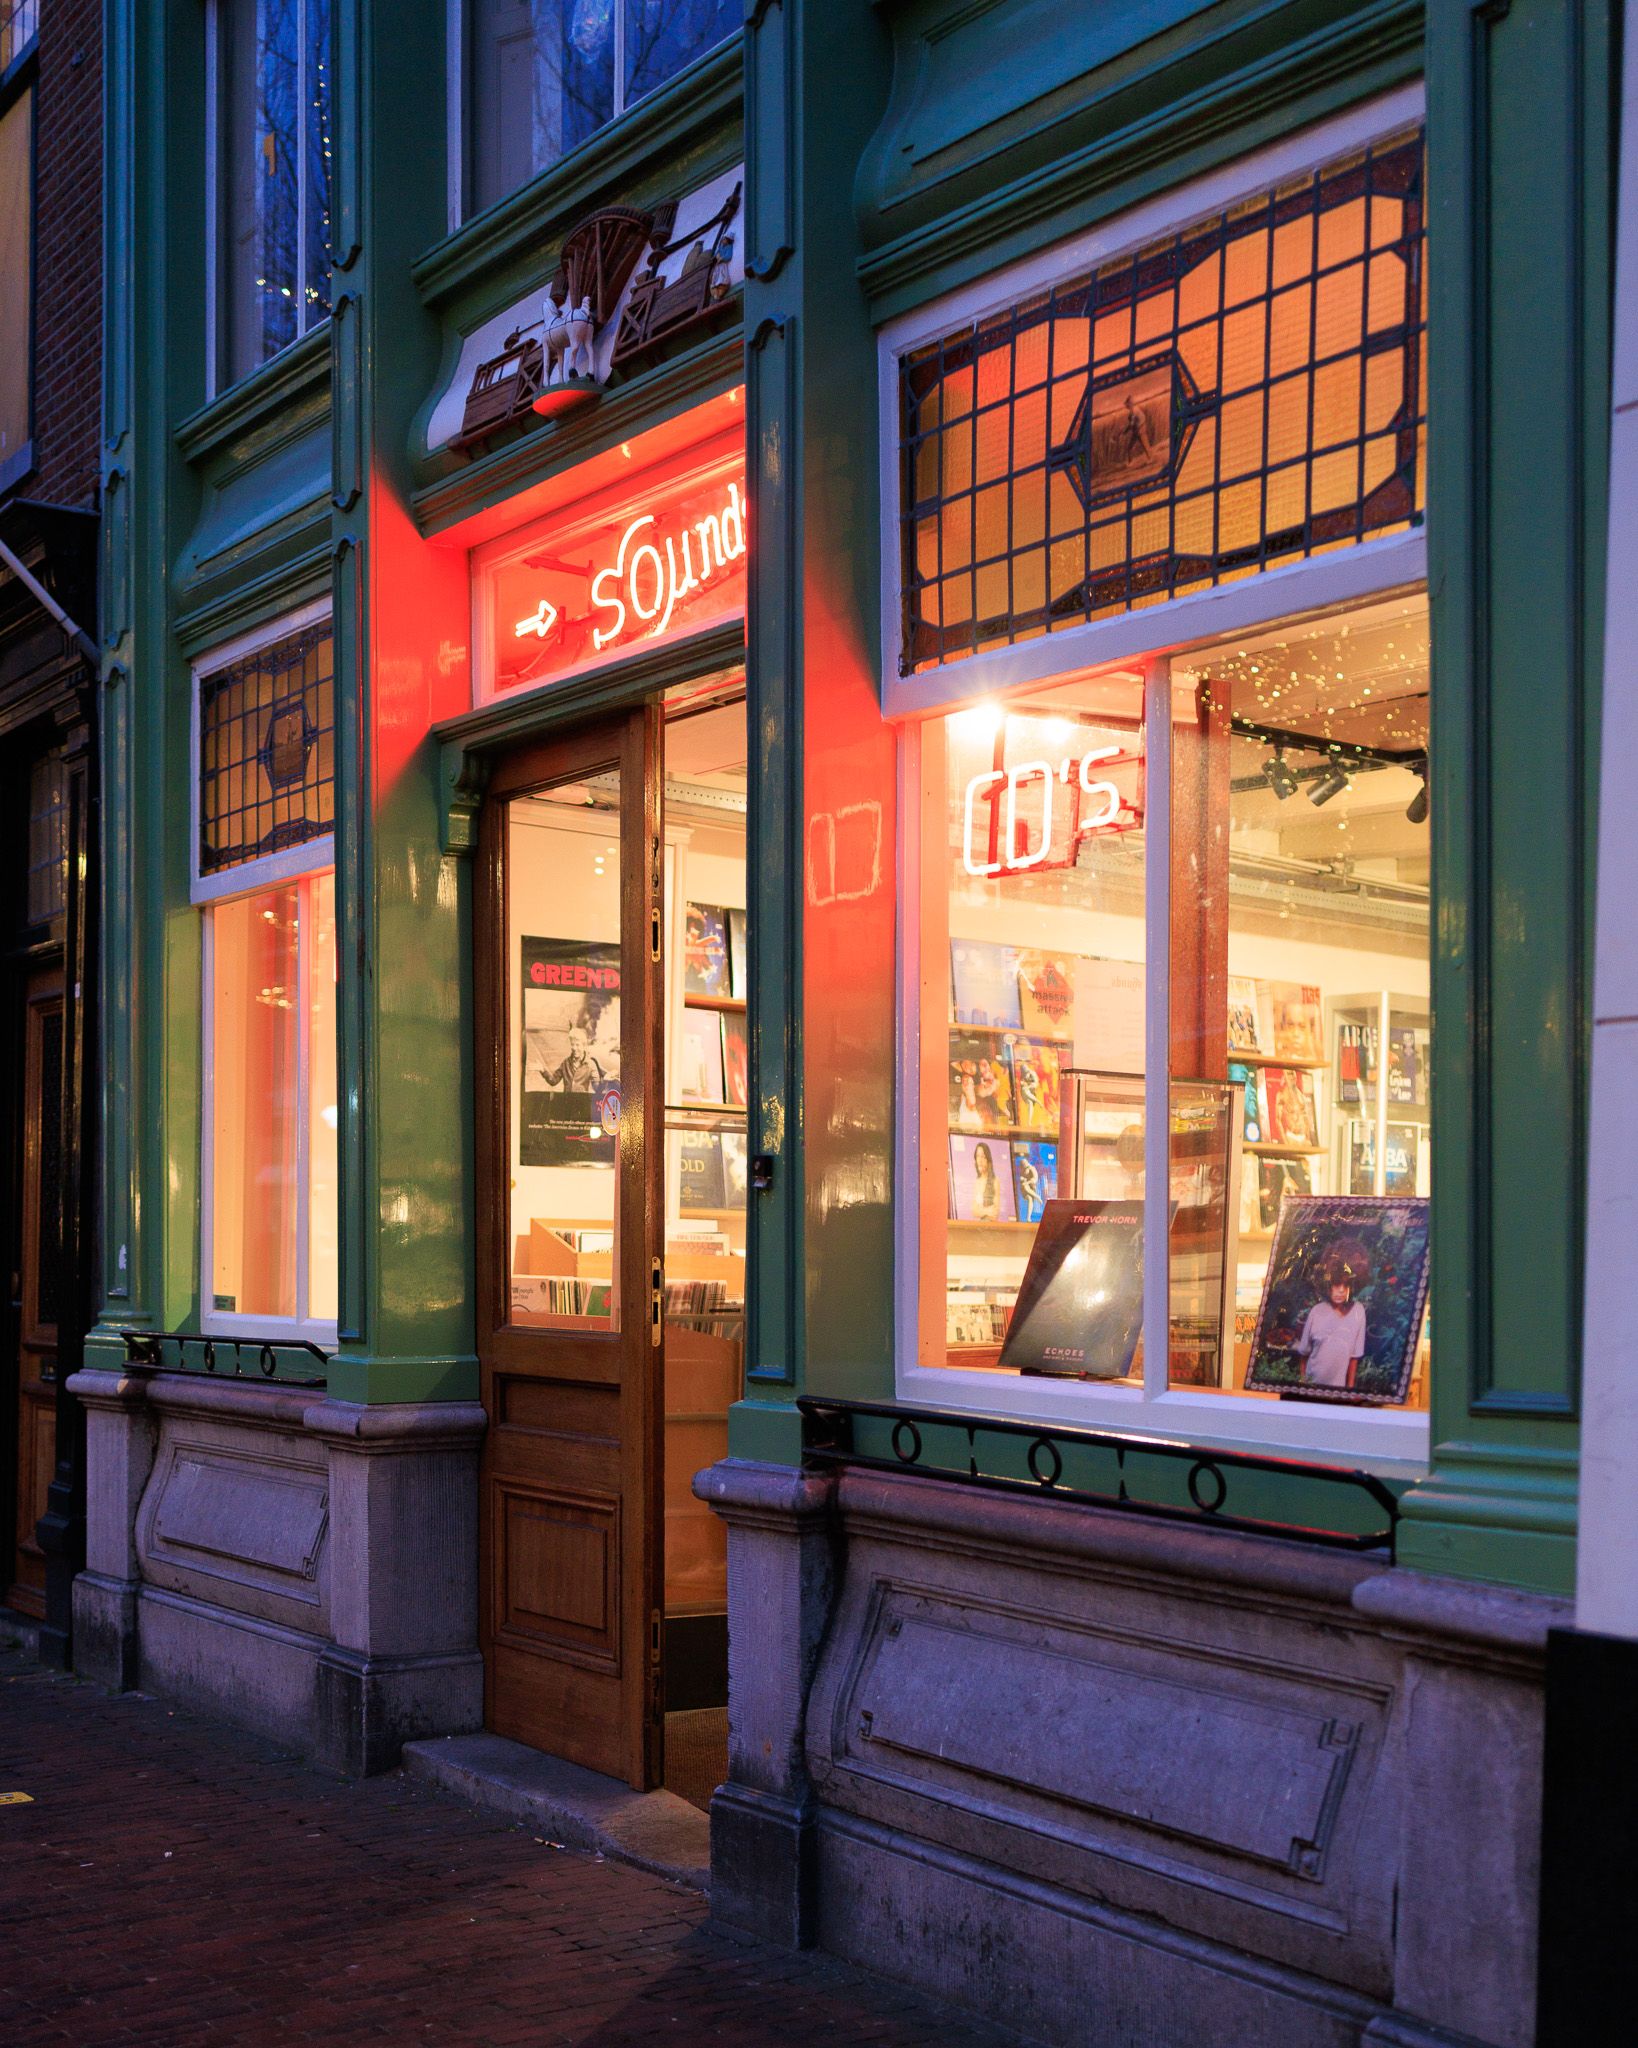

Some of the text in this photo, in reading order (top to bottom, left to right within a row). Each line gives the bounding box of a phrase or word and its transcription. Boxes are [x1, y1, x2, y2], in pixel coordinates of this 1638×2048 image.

[591, 482, 746, 650] Sound
[530, 961, 620, 990] GREEND
[1360, 1143, 1408, 1168] ABA
[1073, 1215, 1108, 1224] TREVOR
[1044, 1347, 1084, 1357] ECHOES
